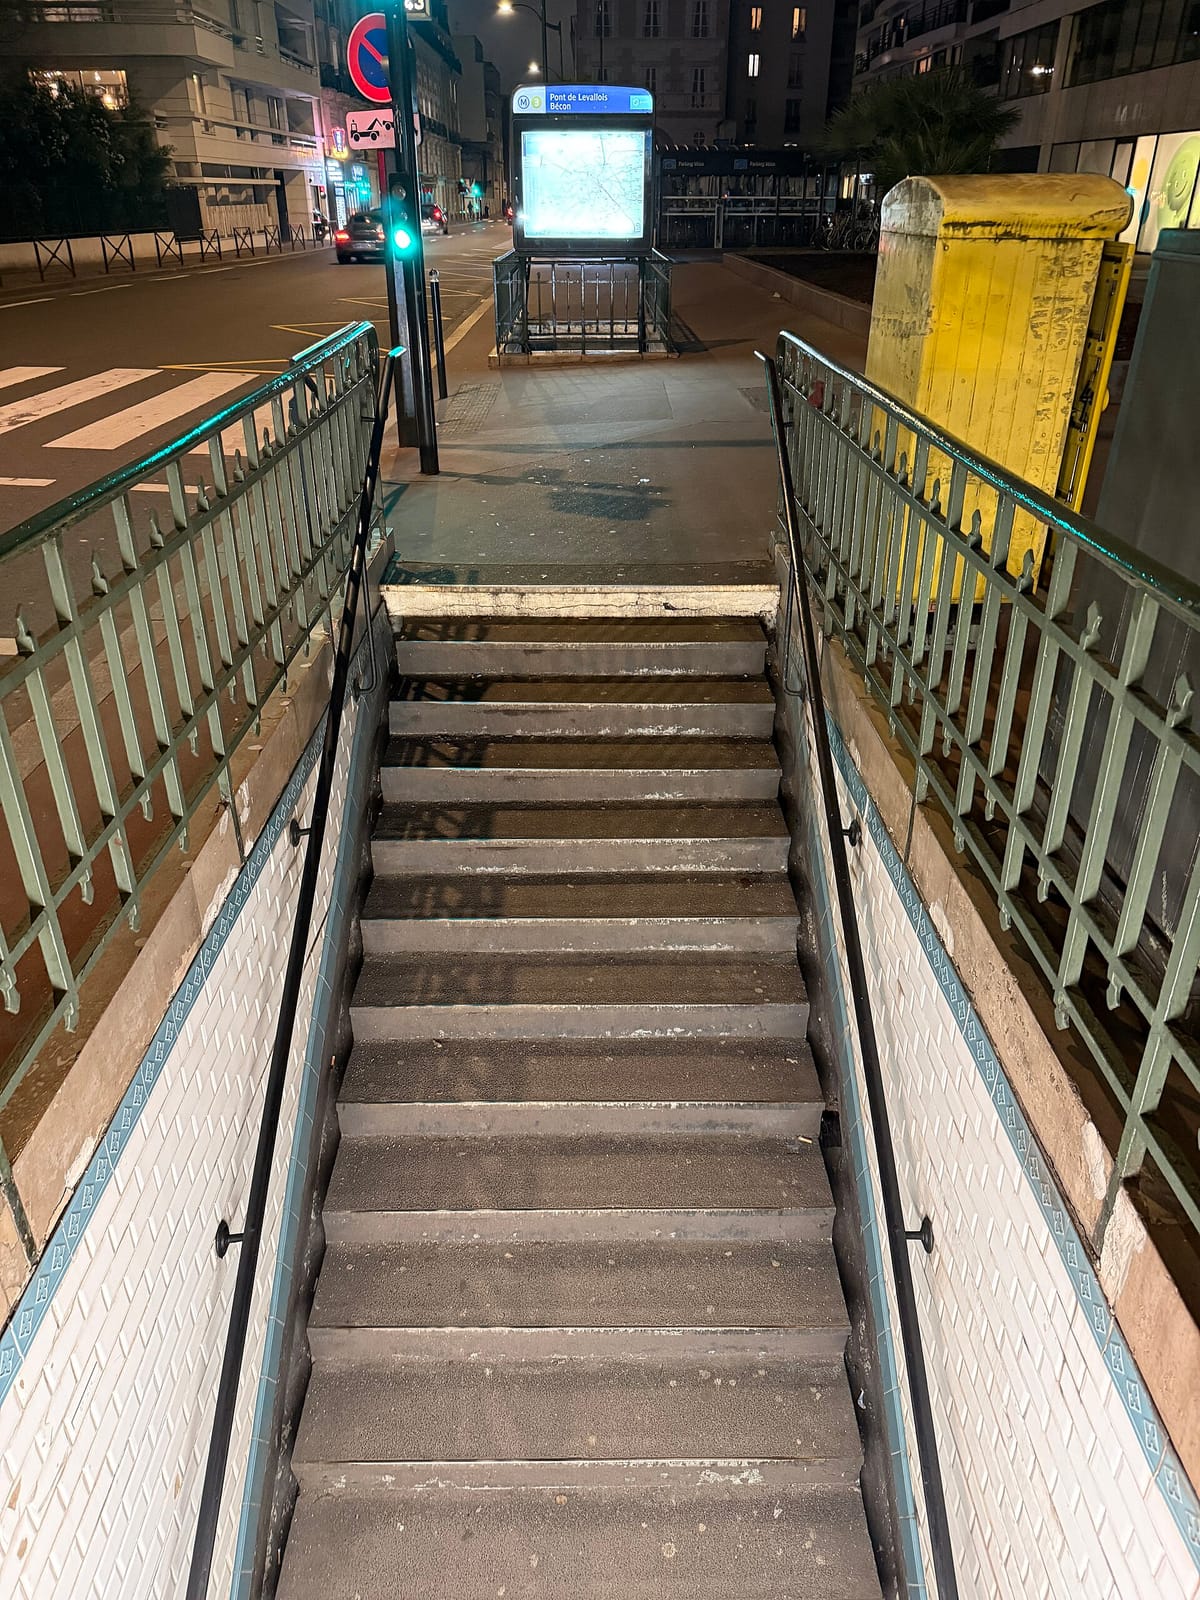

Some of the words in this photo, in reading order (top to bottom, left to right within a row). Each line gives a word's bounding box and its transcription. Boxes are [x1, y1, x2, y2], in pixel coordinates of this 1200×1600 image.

[550, 93, 566, 101] Pont
[567, 93, 576, 101] de
[578, 93, 608, 101] Levallois
[550, 102, 571, 111] Bécon
